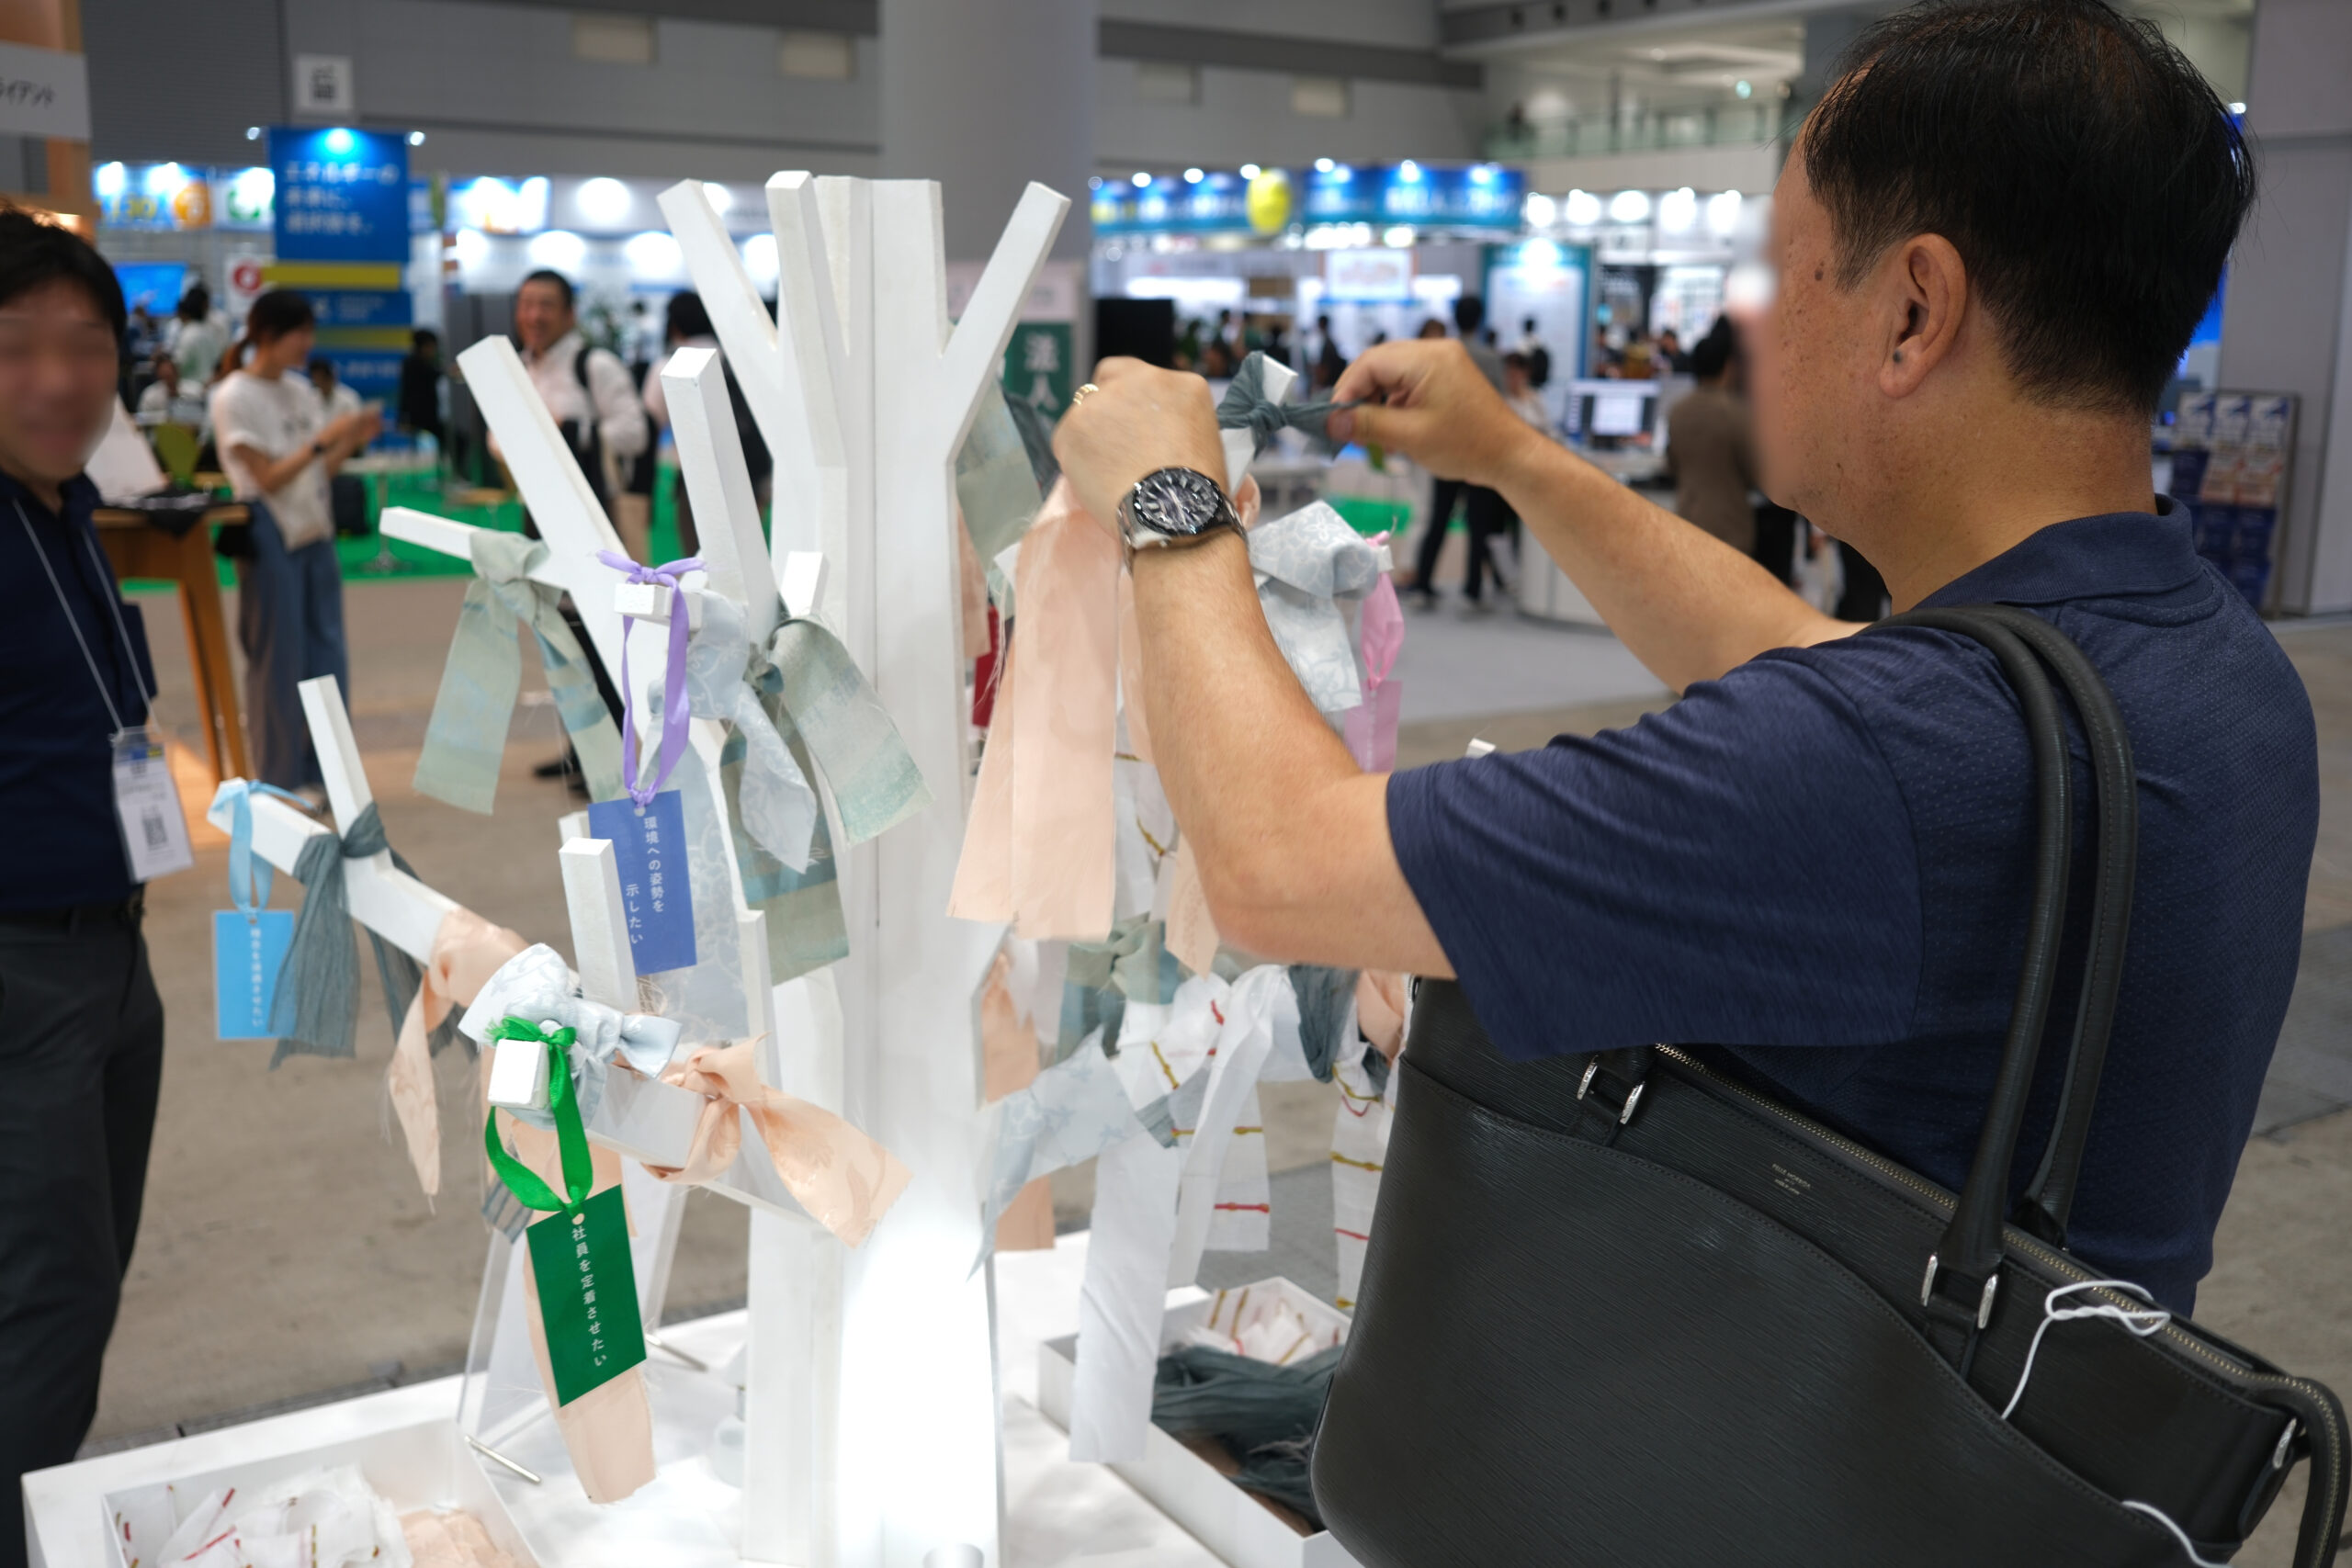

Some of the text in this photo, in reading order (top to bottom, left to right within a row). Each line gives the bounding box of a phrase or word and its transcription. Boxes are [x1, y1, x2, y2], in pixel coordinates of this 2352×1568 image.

[644, 816, 664, 913] 環境への姿勢を
[626, 883, 643, 944] 示したい
[571, 1226, 607, 1367] 社員を定着させたい
